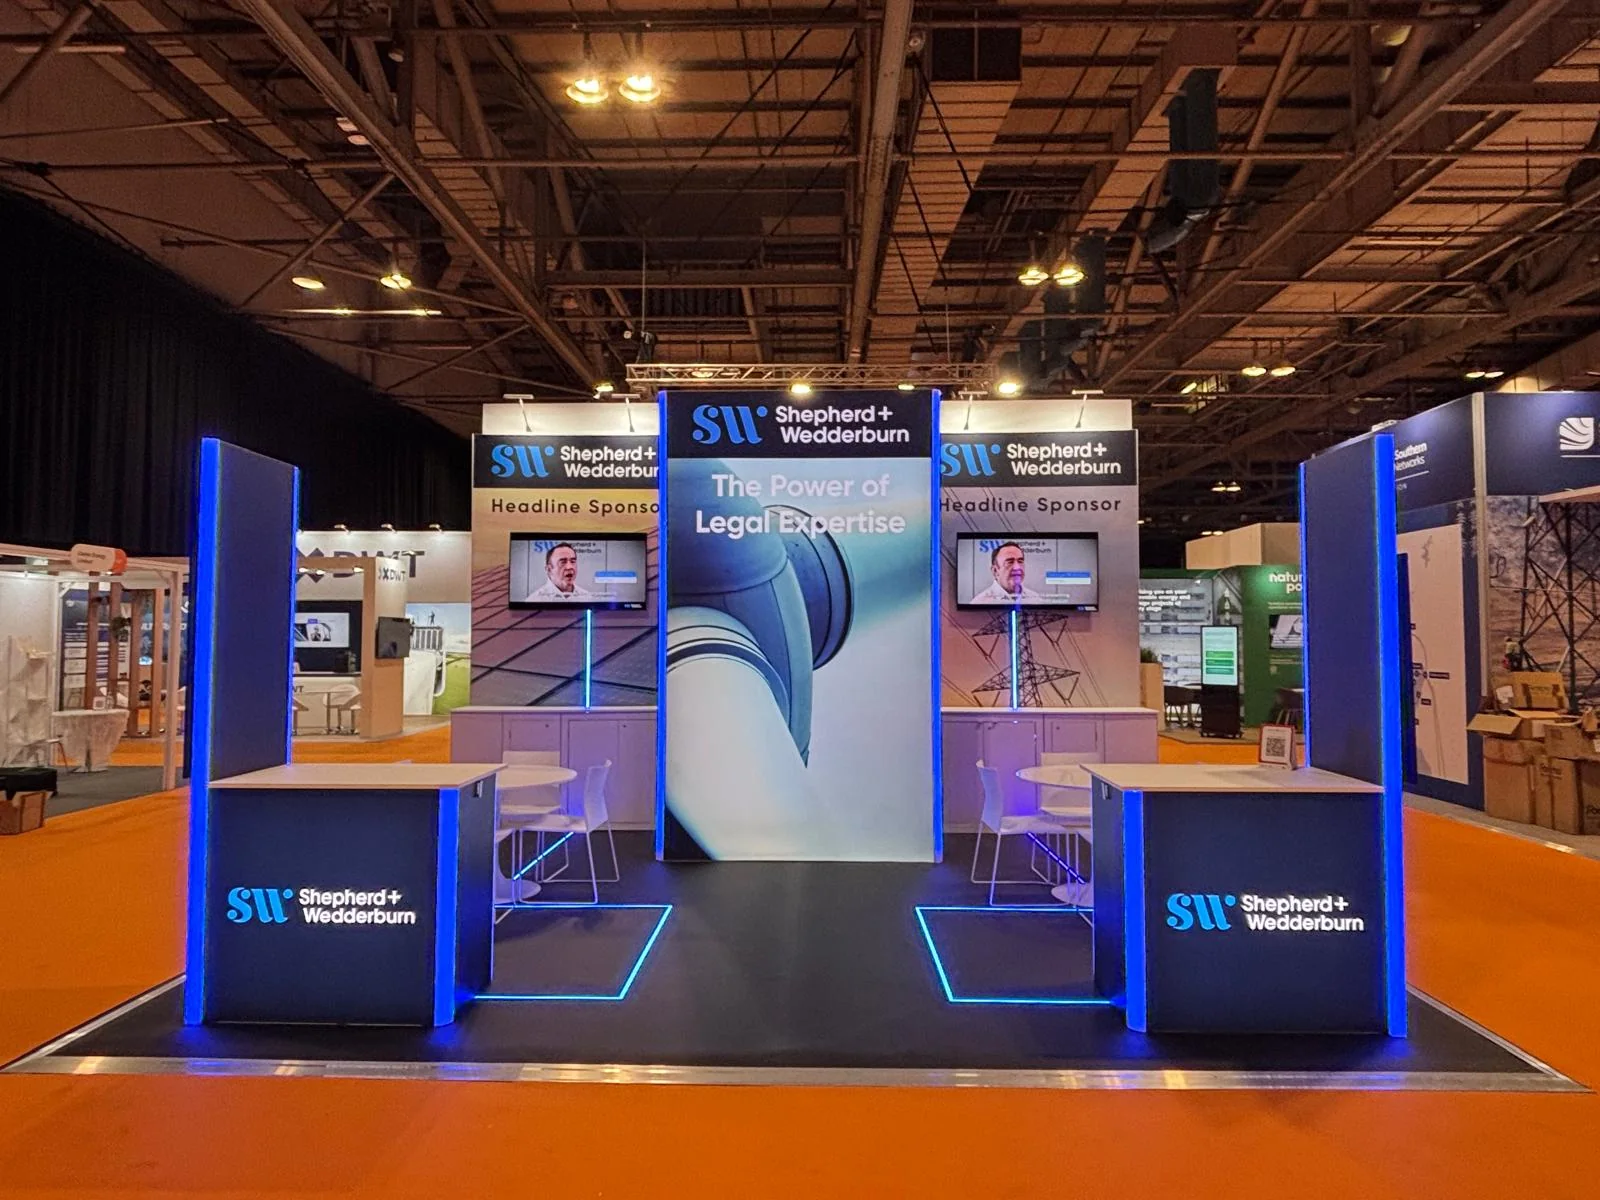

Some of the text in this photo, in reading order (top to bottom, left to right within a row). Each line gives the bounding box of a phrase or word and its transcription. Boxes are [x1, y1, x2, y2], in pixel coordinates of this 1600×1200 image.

[780, 426, 909, 443] Wedderburn
[563, 463, 659, 478] Wedderbur
[1011, 460, 1122, 476] Wedderburn
[711, 473, 890, 497] The Power of
[491, 499, 660, 516] Headline Sponso
[940, 497, 1121, 515] Headline Sponsor
[696, 510, 906, 539] Legal Expertise
[1268, 571, 1302, 583] natur
[303, 907, 416, 924] Wedderburn
[1246, 913, 1364, 931] Wedderburn
